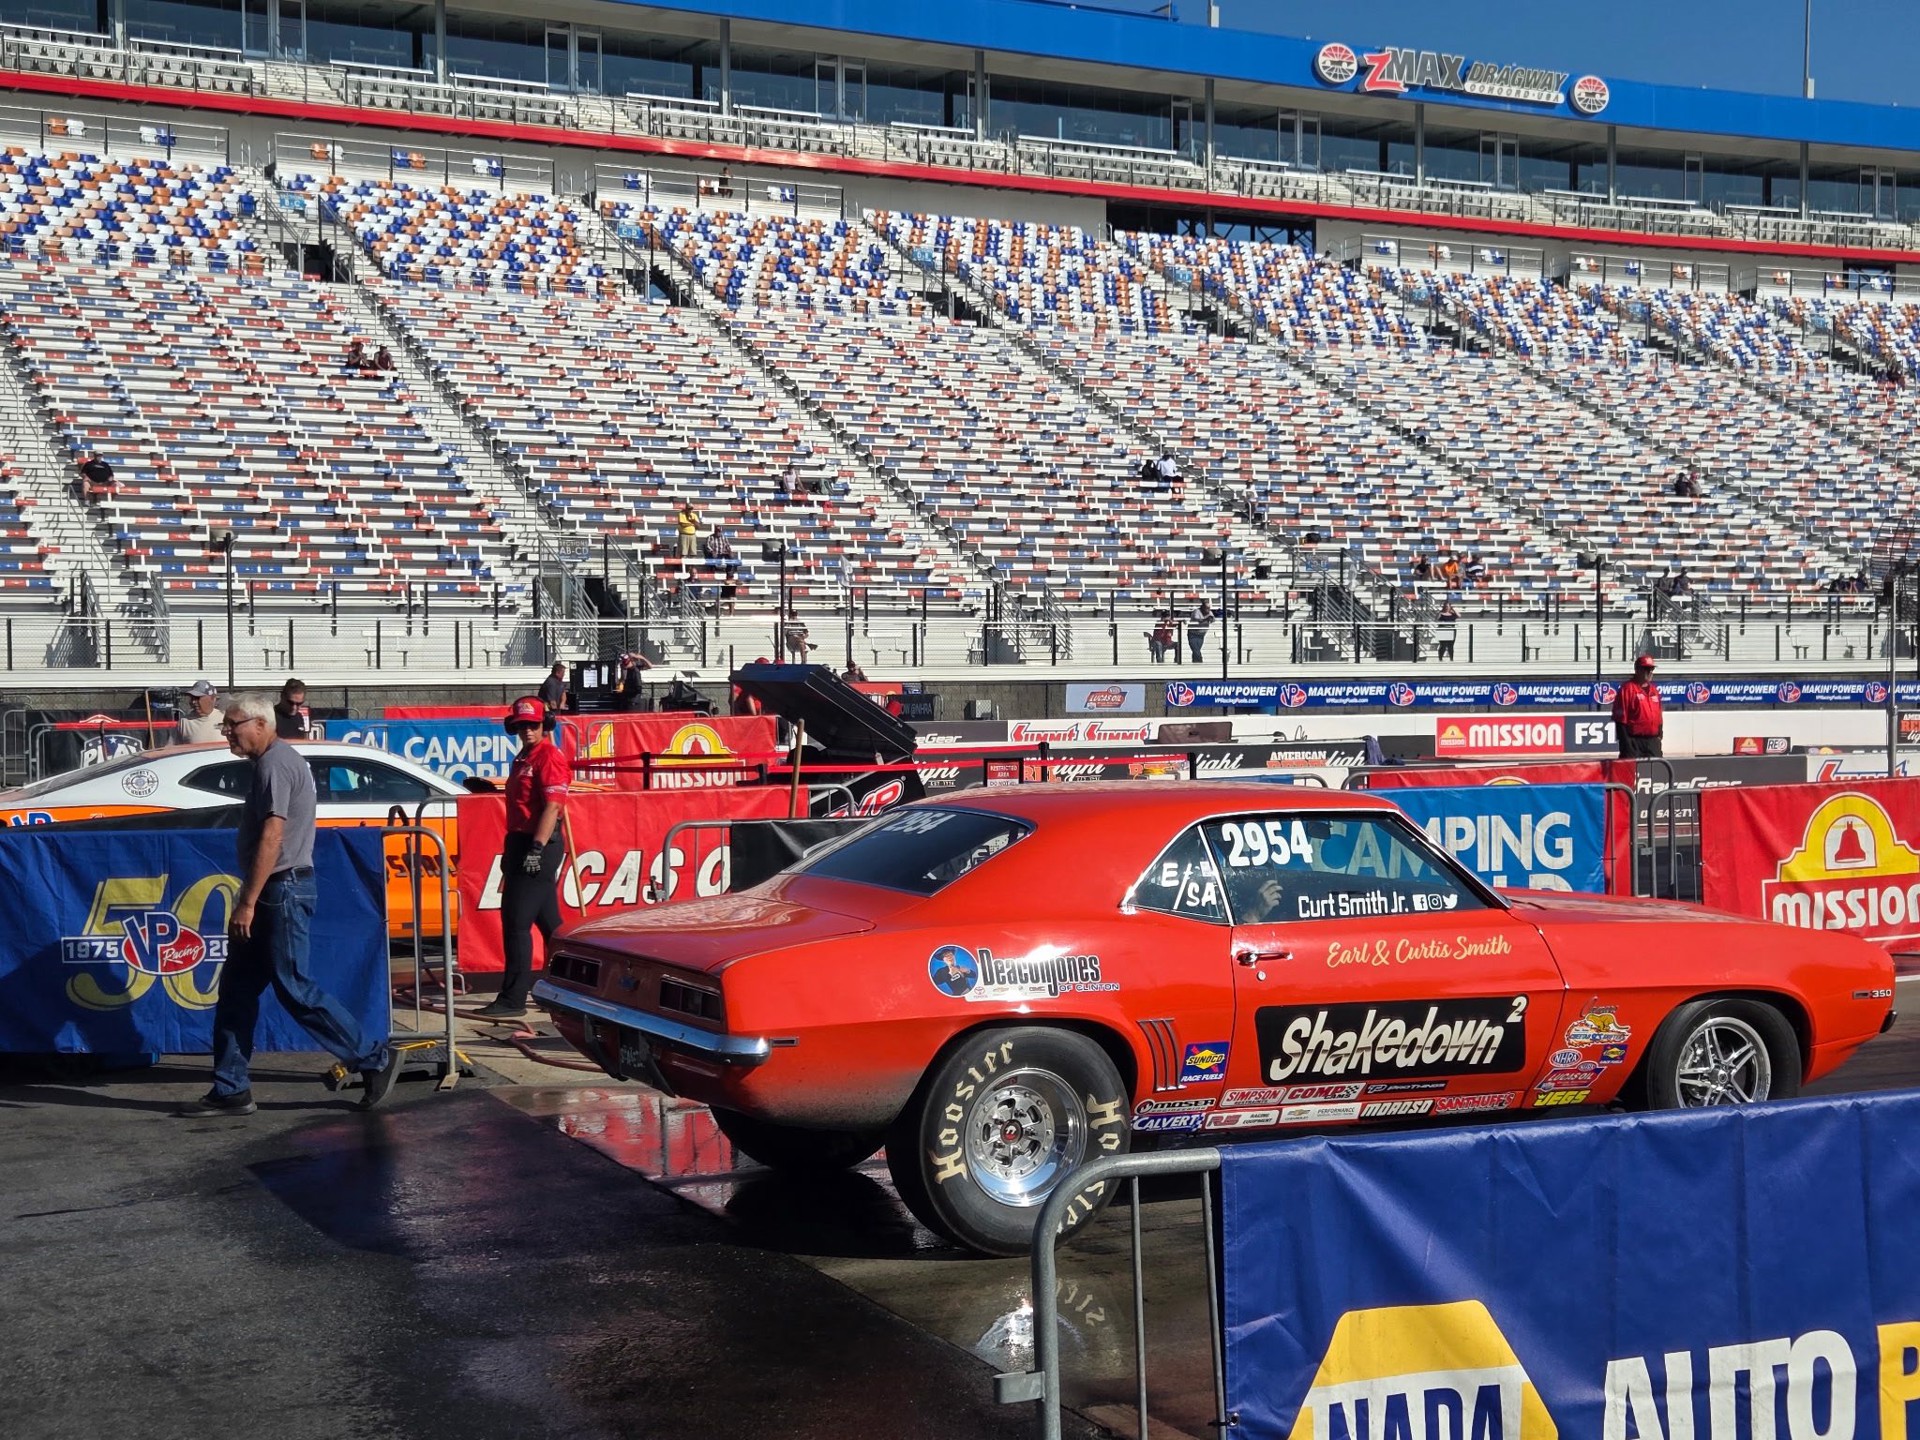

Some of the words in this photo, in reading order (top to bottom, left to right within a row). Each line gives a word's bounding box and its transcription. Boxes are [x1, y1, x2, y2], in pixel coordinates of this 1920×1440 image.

[1468, 61, 1569, 92] DRAGWAY
[1089, 694, 1111, 702] LUCAS
[1168, 682, 1187, 705] VP
[1196, 685, 1234, 697] MAKIN'
[1235, 686, 1277, 697] POWER!
[1281, 684, 1299, 707] VP
[1308, 685, 1345, 697] MAKIN'
[1346, 686, 1387, 696] POWER!
[1389, 682, 1407, 705] VP
[1416, 685, 1451, 696] MAKIN'
[1452, 686, 1490, 696] POWER!
[1494, 682, 1511, 705] VP
[1519, 685, 1552, 696] MAKIN'
[1553, 685, 1590, 695] POWER!
[1594, 682, 1610, 704] VP
[1656, 685, 1687, 695] OWER!
[1687, 682, 1703, 703] VP
[1711, 685, 1742, 694] MAKIN'
[1743, 684, 1777, 694] POWER!
[1779, 682, 1794, 702] VP
[1802, 684, 1831, 694] MAKIN'
[1831, 684, 1864, 694] POWER!
[1866, 682, 1882, 702] VP
[1468, 723, 1562, 747] MISSION
[1574, 722, 1617, 745] FS1
[404, 736, 524, 764] CAMPIN
[1270, 751, 1327, 761] AMERICAN
[1221, 821, 1315, 867] 2954
[478, 847, 685, 910] LCAS
[1298, 895, 1336, 918] Curt
[1338, 889, 1391, 917] Smith
[1391, 890, 1409, 914] Jr.
[66, 941, 119, 959] 1975
[122, 911, 181, 975] VP
[1326, 941, 1370, 968] Earl
[1371, 939, 1390, 966] &
[1395, 938, 1452, 964] Curtis
[1453, 934, 1512, 960] Smith
[162, 945, 204, 966] Racing
[1059, 984, 1074, 993] OF
[1075, 982, 1120, 992] CLINTON
[1872, 989, 1892, 998] 350
[1506, 995, 1527, 1023] 2
[1269, 1006, 1505, 1081] Shakedown
[1188, 1054, 1224, 1065] SUNOCO
[1554, 1054, 1578, 1065] NHRA
[1181, 1074, 1200, 1083] RACE
[1201, 1073, 1224, 1081] FUELS
[1227, 1089, 1280, 1101] SIMPSON
[1288, 1085, 1346, 1100] COMP
[1436, 1092, 1516, 1110] SANTHUFF'S
[1533, 1089, 1591, 1106] JEGS
[1317, 1106, 1355, 1114] PERFORMANCE
[1360, 1100, 1434, 1117] MOROSO
[1133, 1113, 1198, 1130] CALVERT
